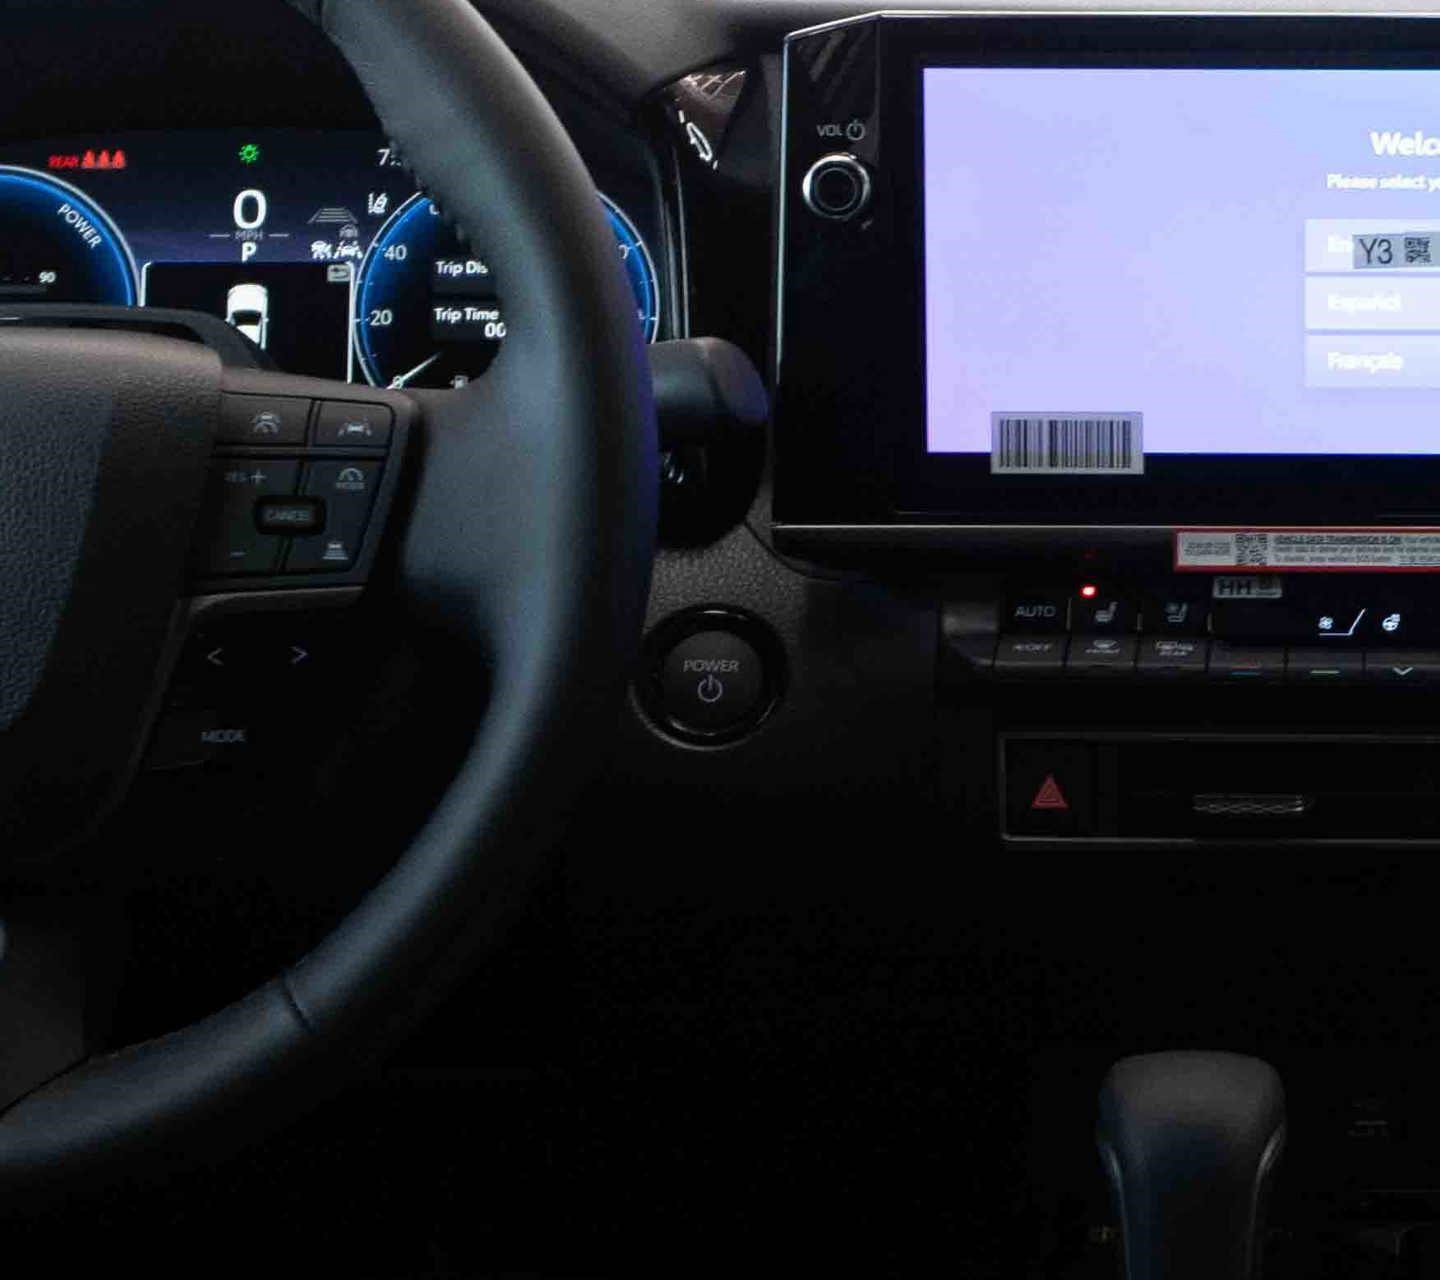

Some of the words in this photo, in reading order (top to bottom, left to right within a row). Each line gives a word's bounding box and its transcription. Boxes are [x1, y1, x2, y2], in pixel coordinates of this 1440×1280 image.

[1326, 173, 1378, 189] Please
[1379, 173, 1426, 189] select
[232, 188, 268, 230] 0
[56, 203, 103, 250] POWER
[241, 242, 257, 262] P
[384, 245, 408, 261] 40
[1358, 238, 1393, 265] Y3
[435, 260, 463, 277] Trip
[465, 260, 489, 275] Dis
[38, 271, 57, 284] 90
[369, 310, 393, 326] 20
[433, 307, 462, 322] Trip
[464, 307, 499, 321] Time
[1014, 605, 1057, 619] AUTO
[683, 659, 740, 673] POWER
